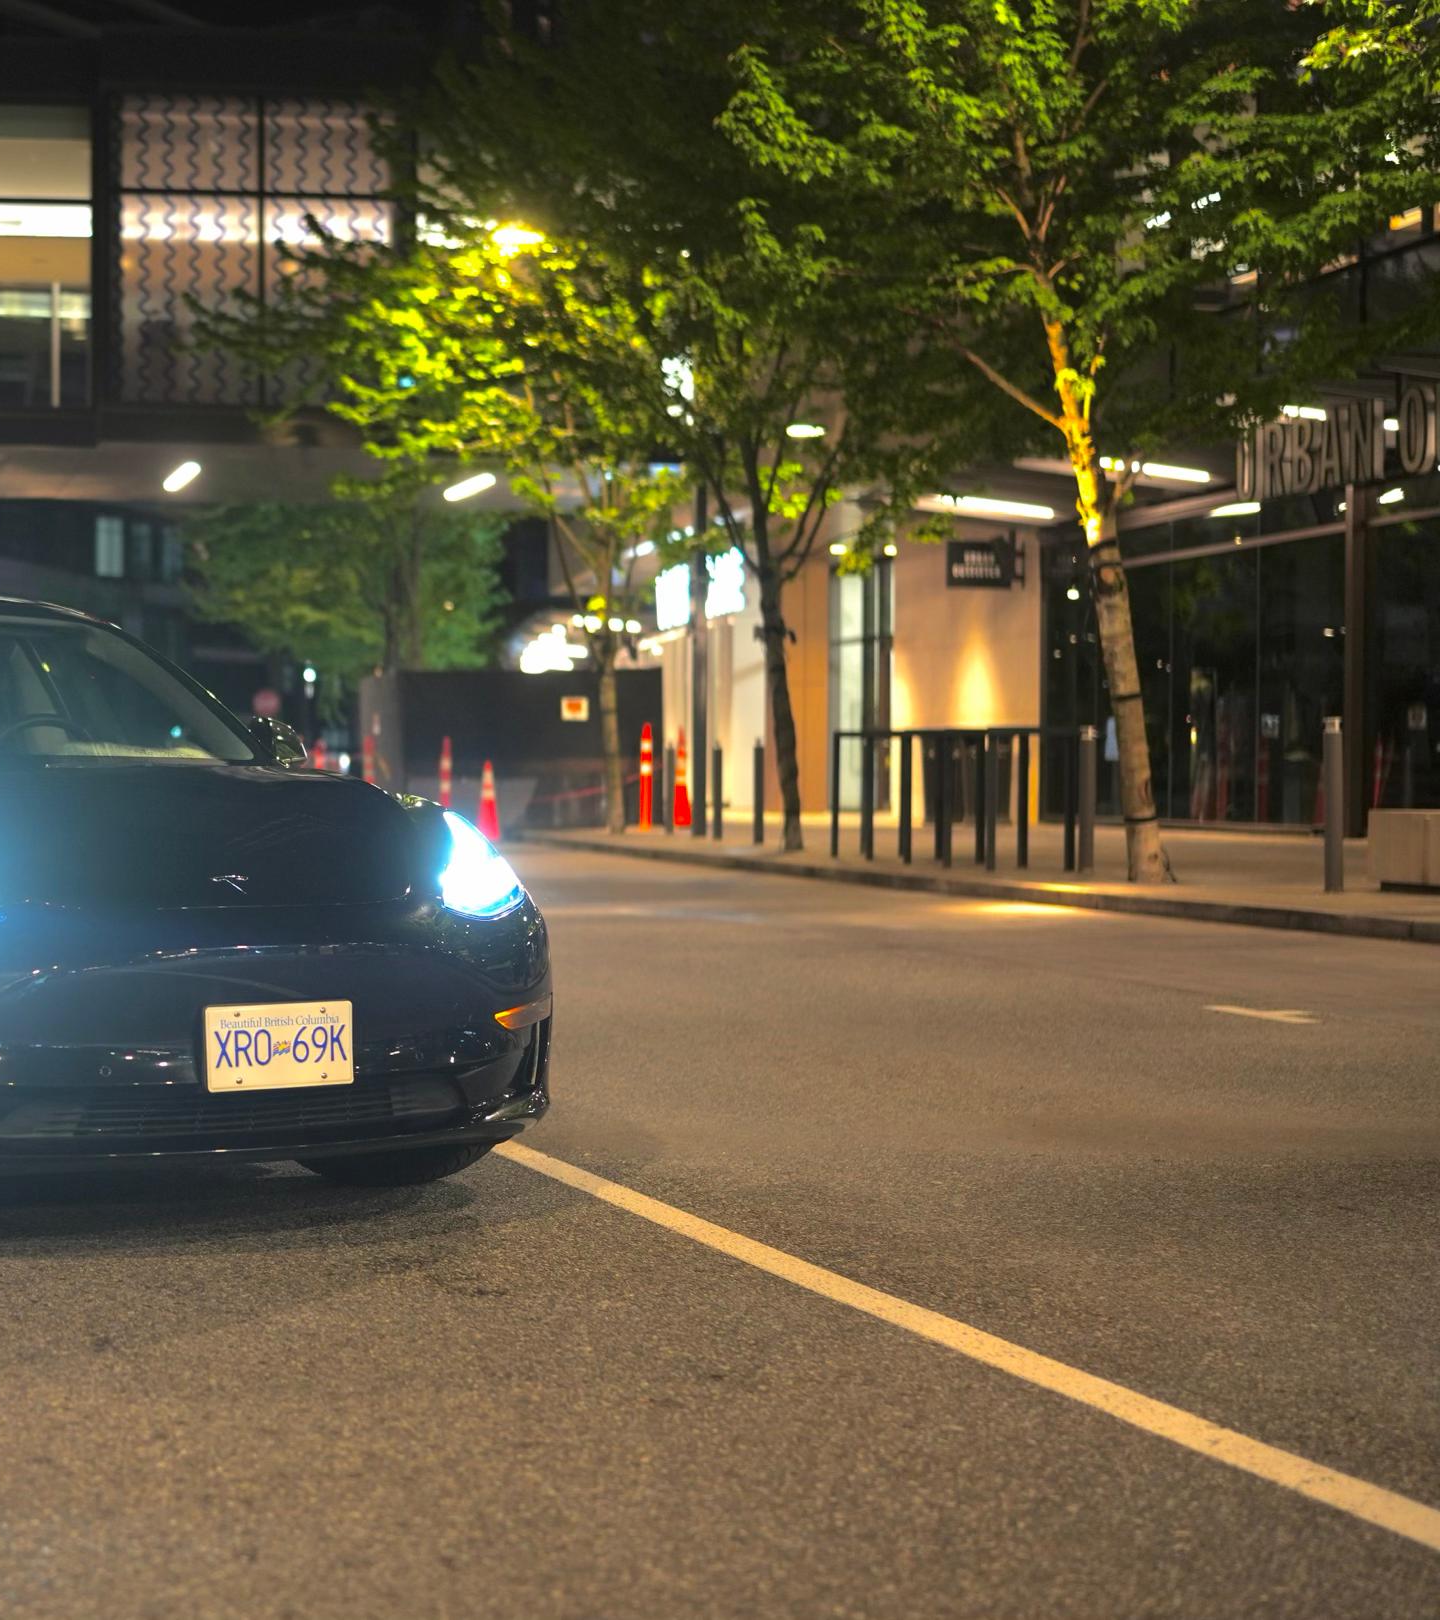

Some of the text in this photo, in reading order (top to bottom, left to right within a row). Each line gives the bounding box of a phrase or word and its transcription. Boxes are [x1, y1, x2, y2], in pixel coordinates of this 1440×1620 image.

[1236, 386, 1440, 501] URBAN O
[220, 1013, 340, 1029] Beautiful British Columbia
[292, 1024, 348, 1063] 69K
